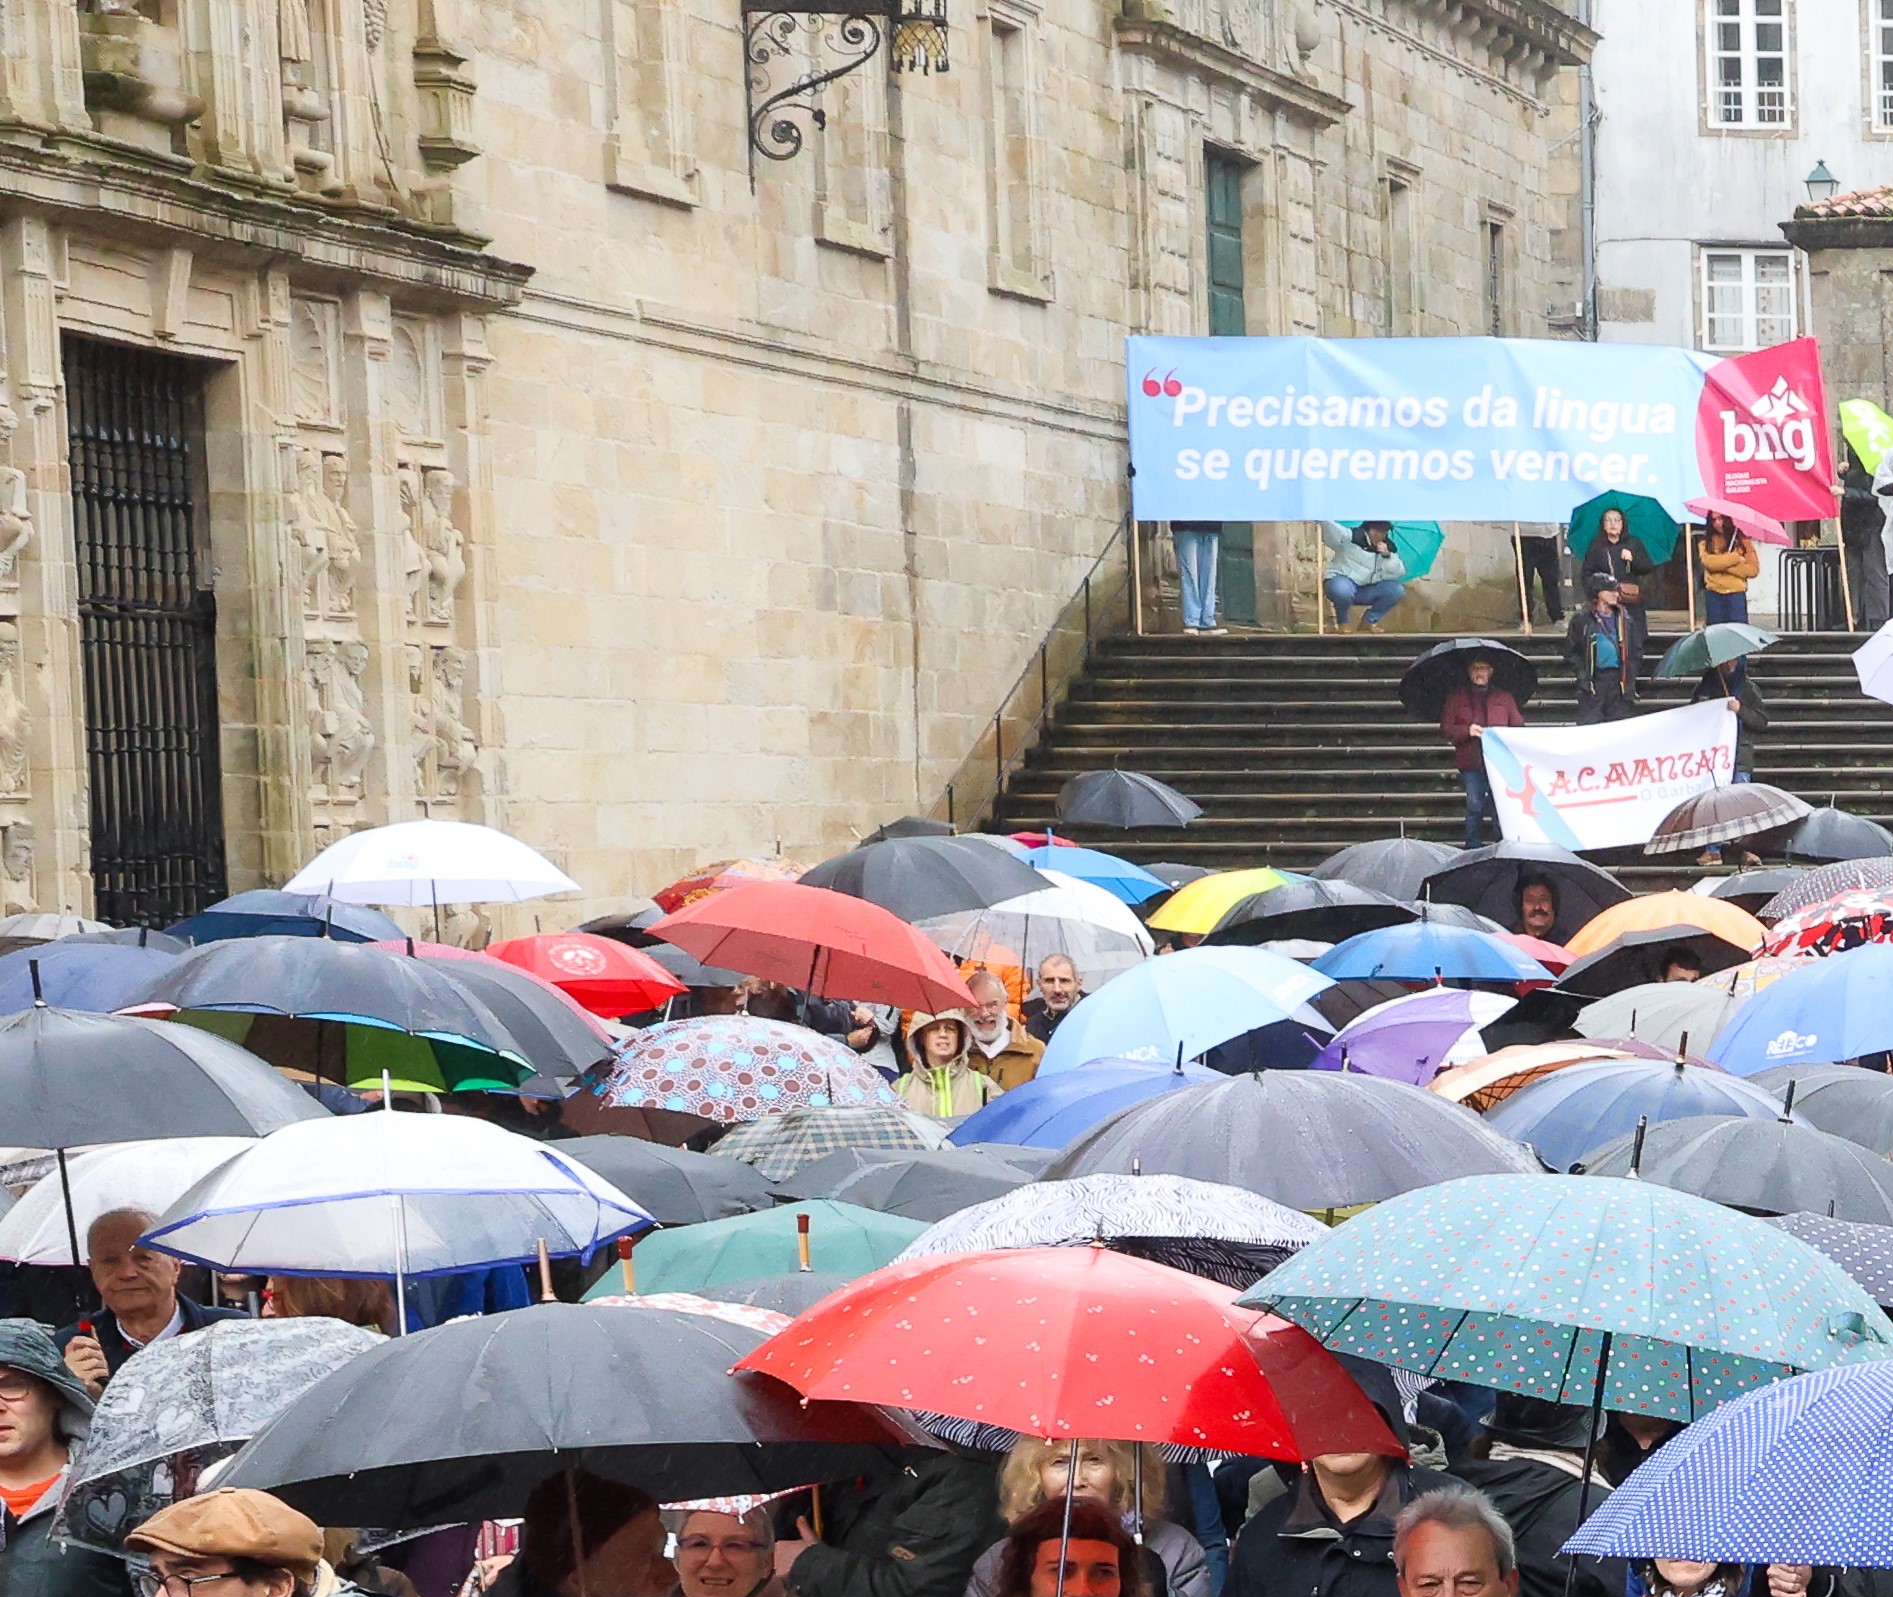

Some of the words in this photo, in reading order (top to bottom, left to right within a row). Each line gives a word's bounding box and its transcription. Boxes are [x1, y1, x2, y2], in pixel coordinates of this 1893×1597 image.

[1461, 383, 1518, 429] da
[1532, 385, 1676, 442] lingua
[1719, 409, 1816, 472] bng
[1174, 448, 1231, 481] se
[1243, 448, 1475, 492] queremos
[1489, 448, 1658, 485] vencer.
